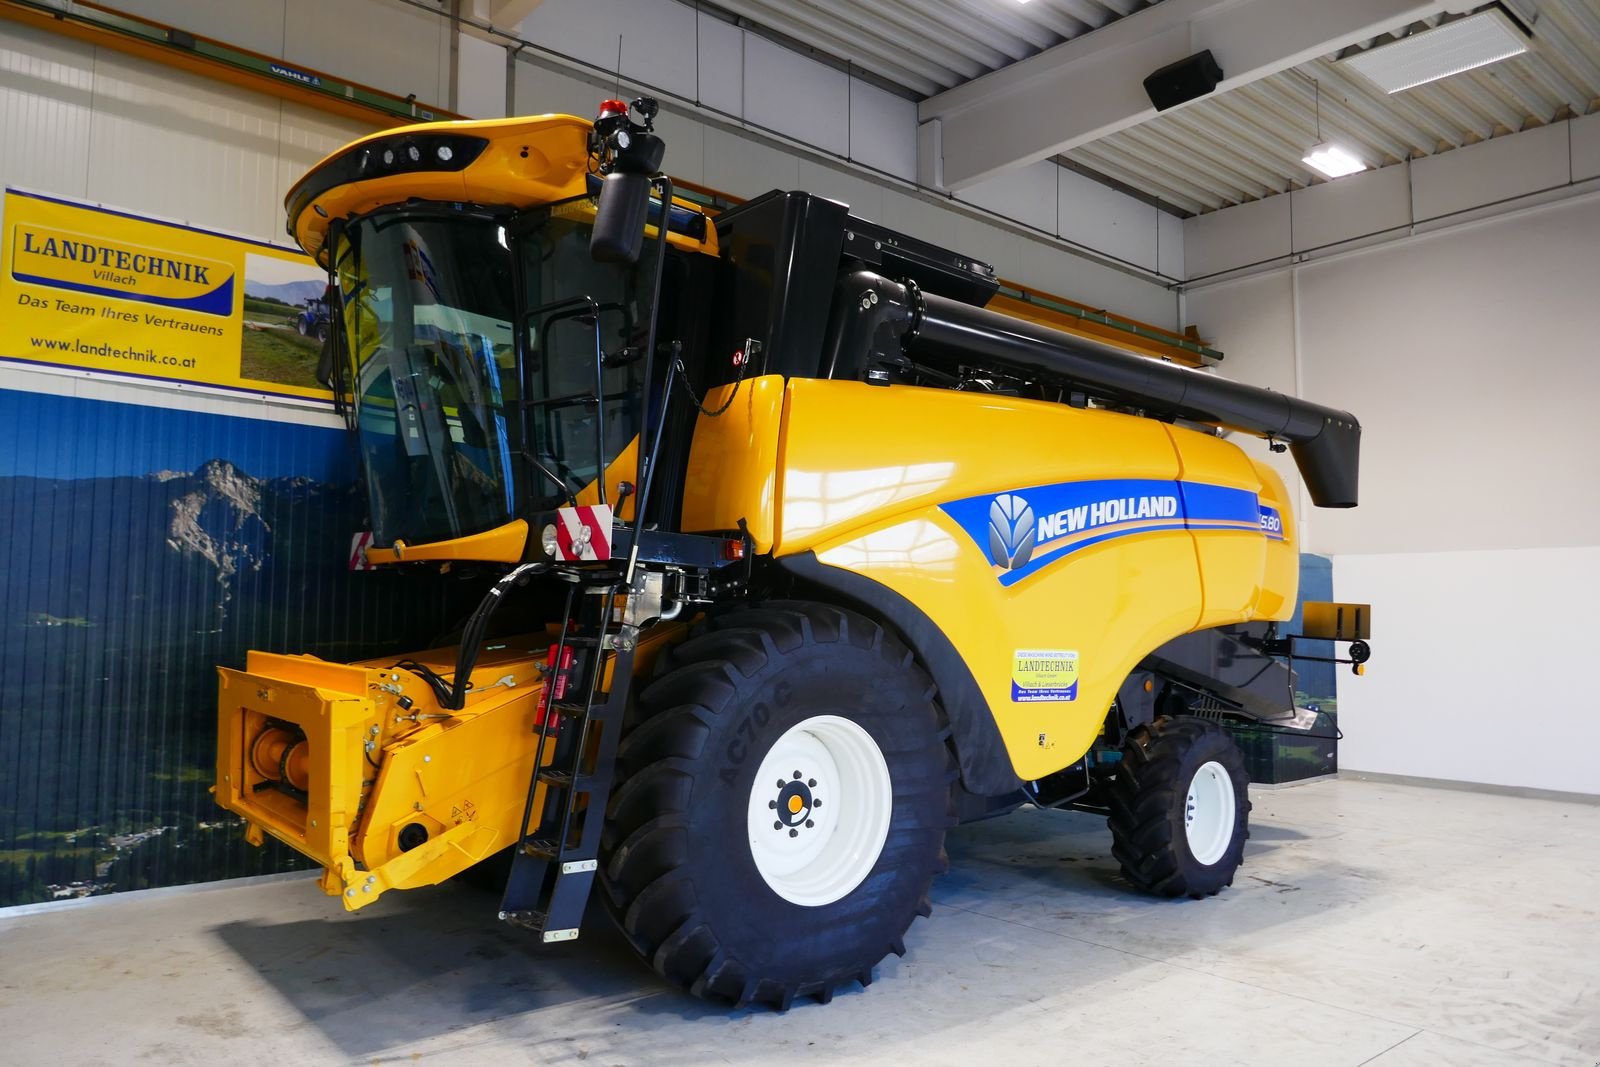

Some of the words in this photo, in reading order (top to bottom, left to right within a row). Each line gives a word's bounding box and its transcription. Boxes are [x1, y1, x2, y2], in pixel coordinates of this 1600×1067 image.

[270, 66, 311, 83] VAHLE
[23, 232, 211, 286] LANDTECHNIK
[93, 269, 137, 286] Villach
[18, 293, 49, 309] Das
[55, 299, 96, 317] Team
[101, 306, 140, 323] Ihres
[145, 313, 224, 337] Vertrauens
[31, 336, 197, 369] www.landtechnik.co.at
[1037, 505, 1089, 542] NEW
[1090, 496, 1177, 526] HOLLAND
[1018, 660, 1074, 672] LANDTECHNIK
